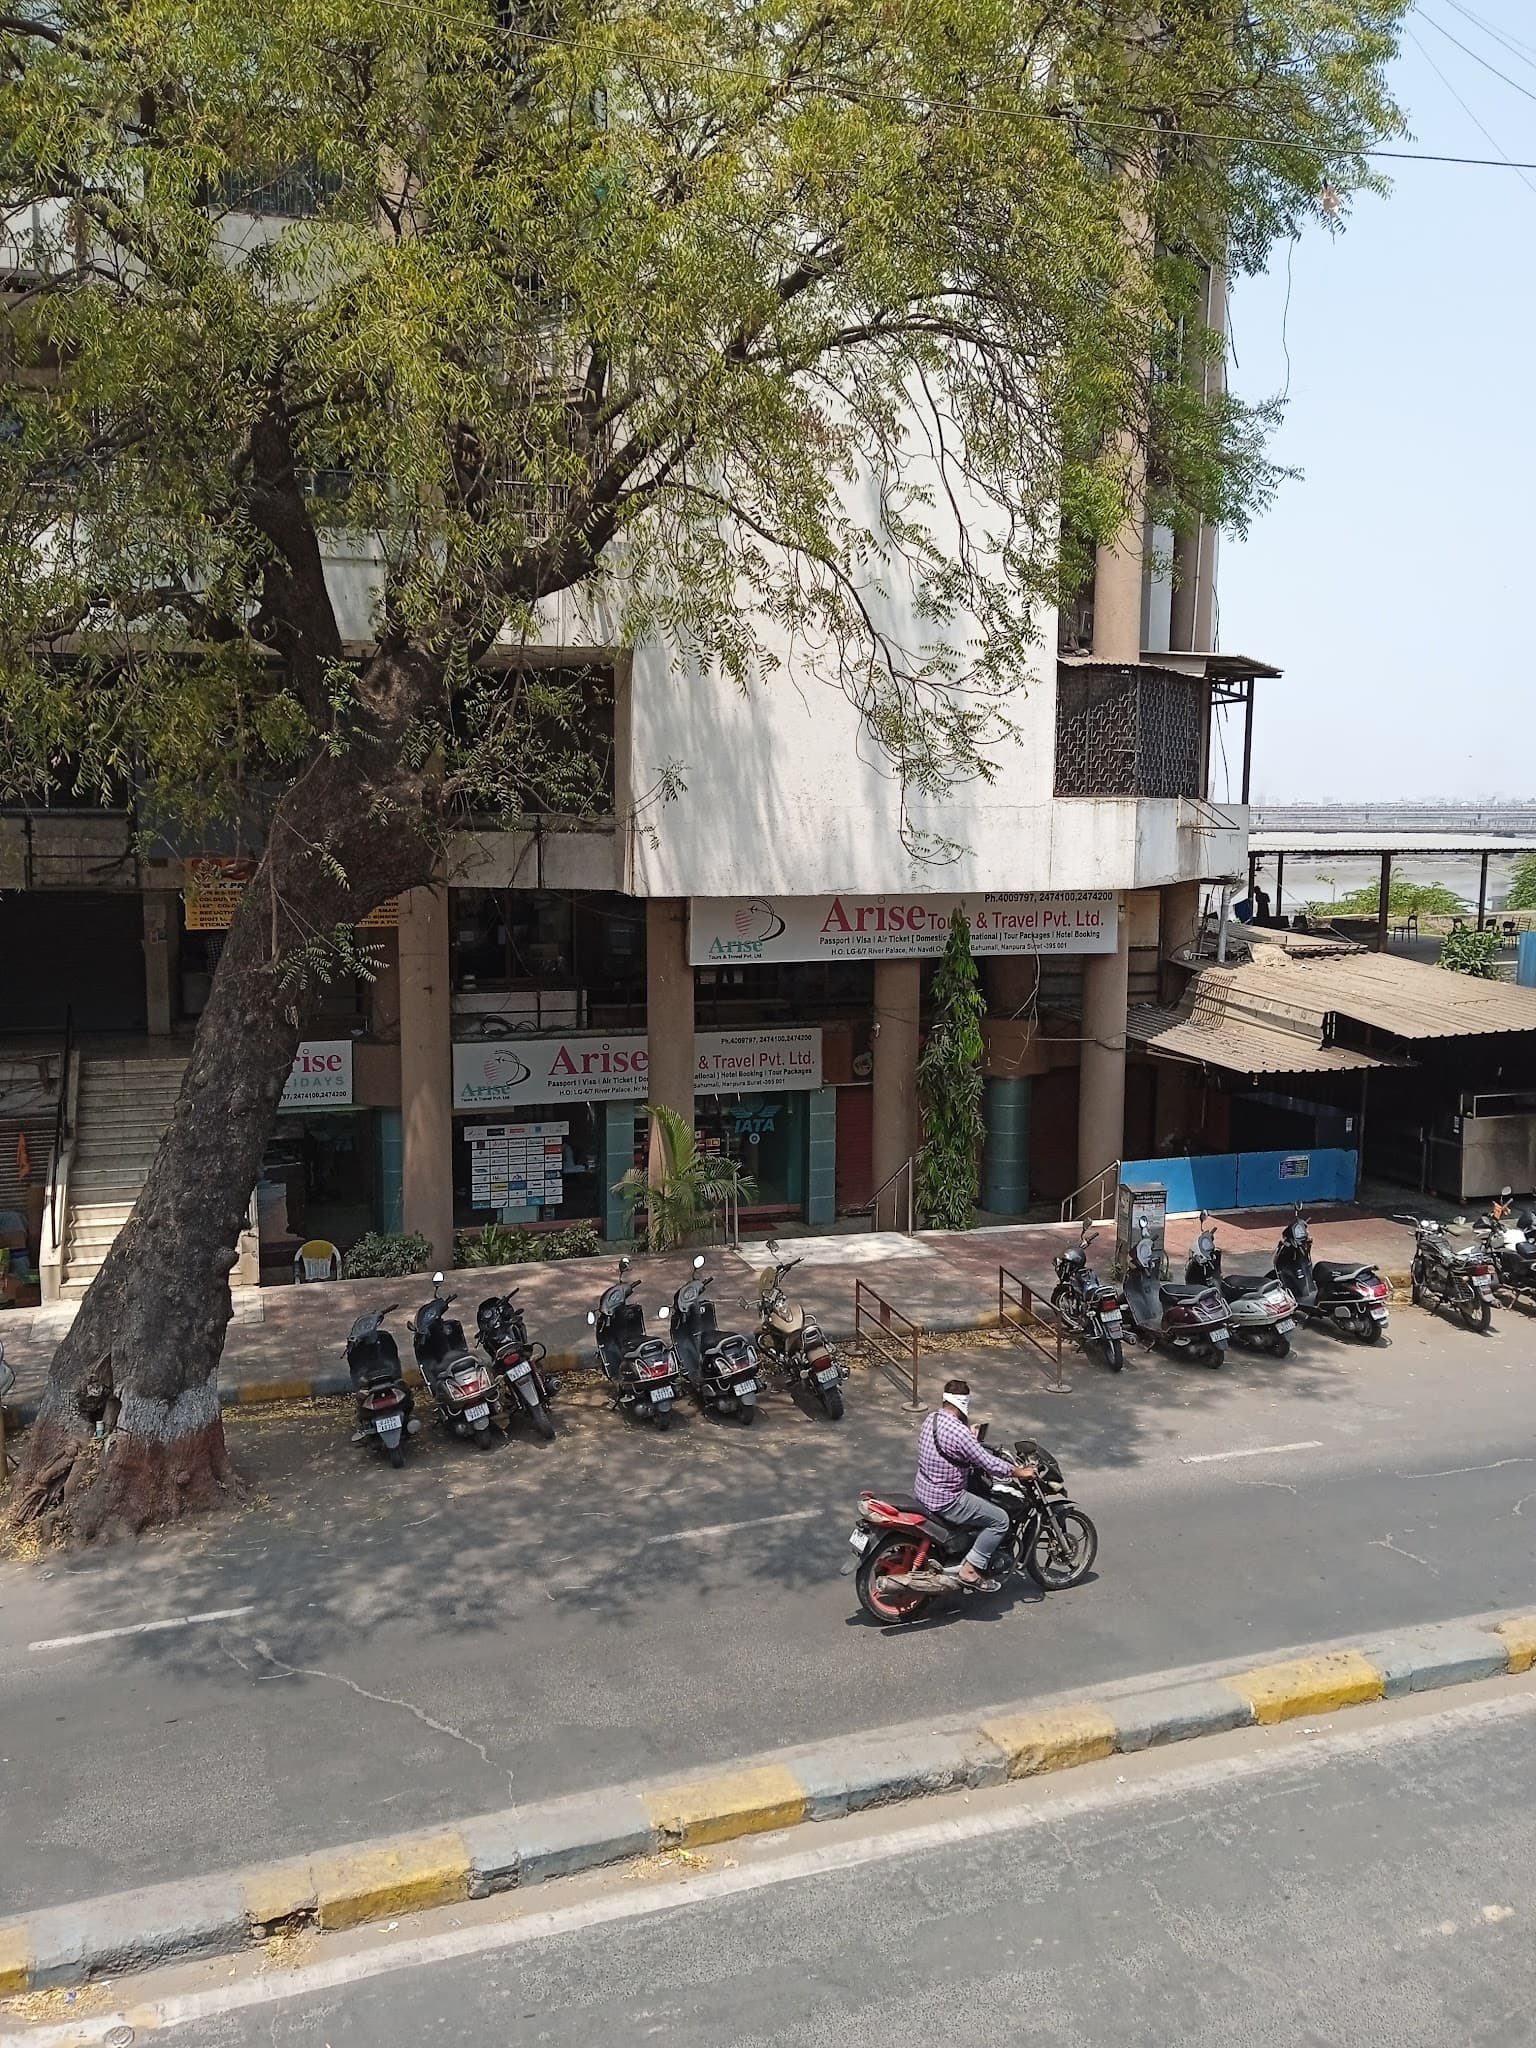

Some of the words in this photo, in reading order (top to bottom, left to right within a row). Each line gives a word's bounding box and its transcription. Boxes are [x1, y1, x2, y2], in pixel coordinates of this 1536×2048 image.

[819, 896, 926, 933] Arise
[976, 911, 988, 929] &
[991, 910, 1038, 928] Travel
[1043, 910, 1071, 928] Pvt.
[1076, 909, 1104, 927] Ltd.
[708, 935, 763, 954] Arise
[819, 936, 850, 946] Passport
[856, 935, 872, 944] Visa
[877, 935, 888, 943] Air
[888, 934, 910, 943] Ticket
[916, 933, 946, 942] Domestic
[1003, 932, 1018, 940] Tour
[1055, 930, 1073, 938] Hotel
[1074, 929, 1100, 939] Booking
[547, 1043, 648, 1076] Arise
[698, 1055, 709, 1070] &
[712, 1052, 755, 1069] Travel
[760, 1052, 785, 1067] Pvt.
[789, 1050, 815, 1065] Ltd.
[293, 1076, 345, 1088] IDAYS
[461, 1083, 512, 1097] Arise
[734, 1118, 776, 1133] IATA
